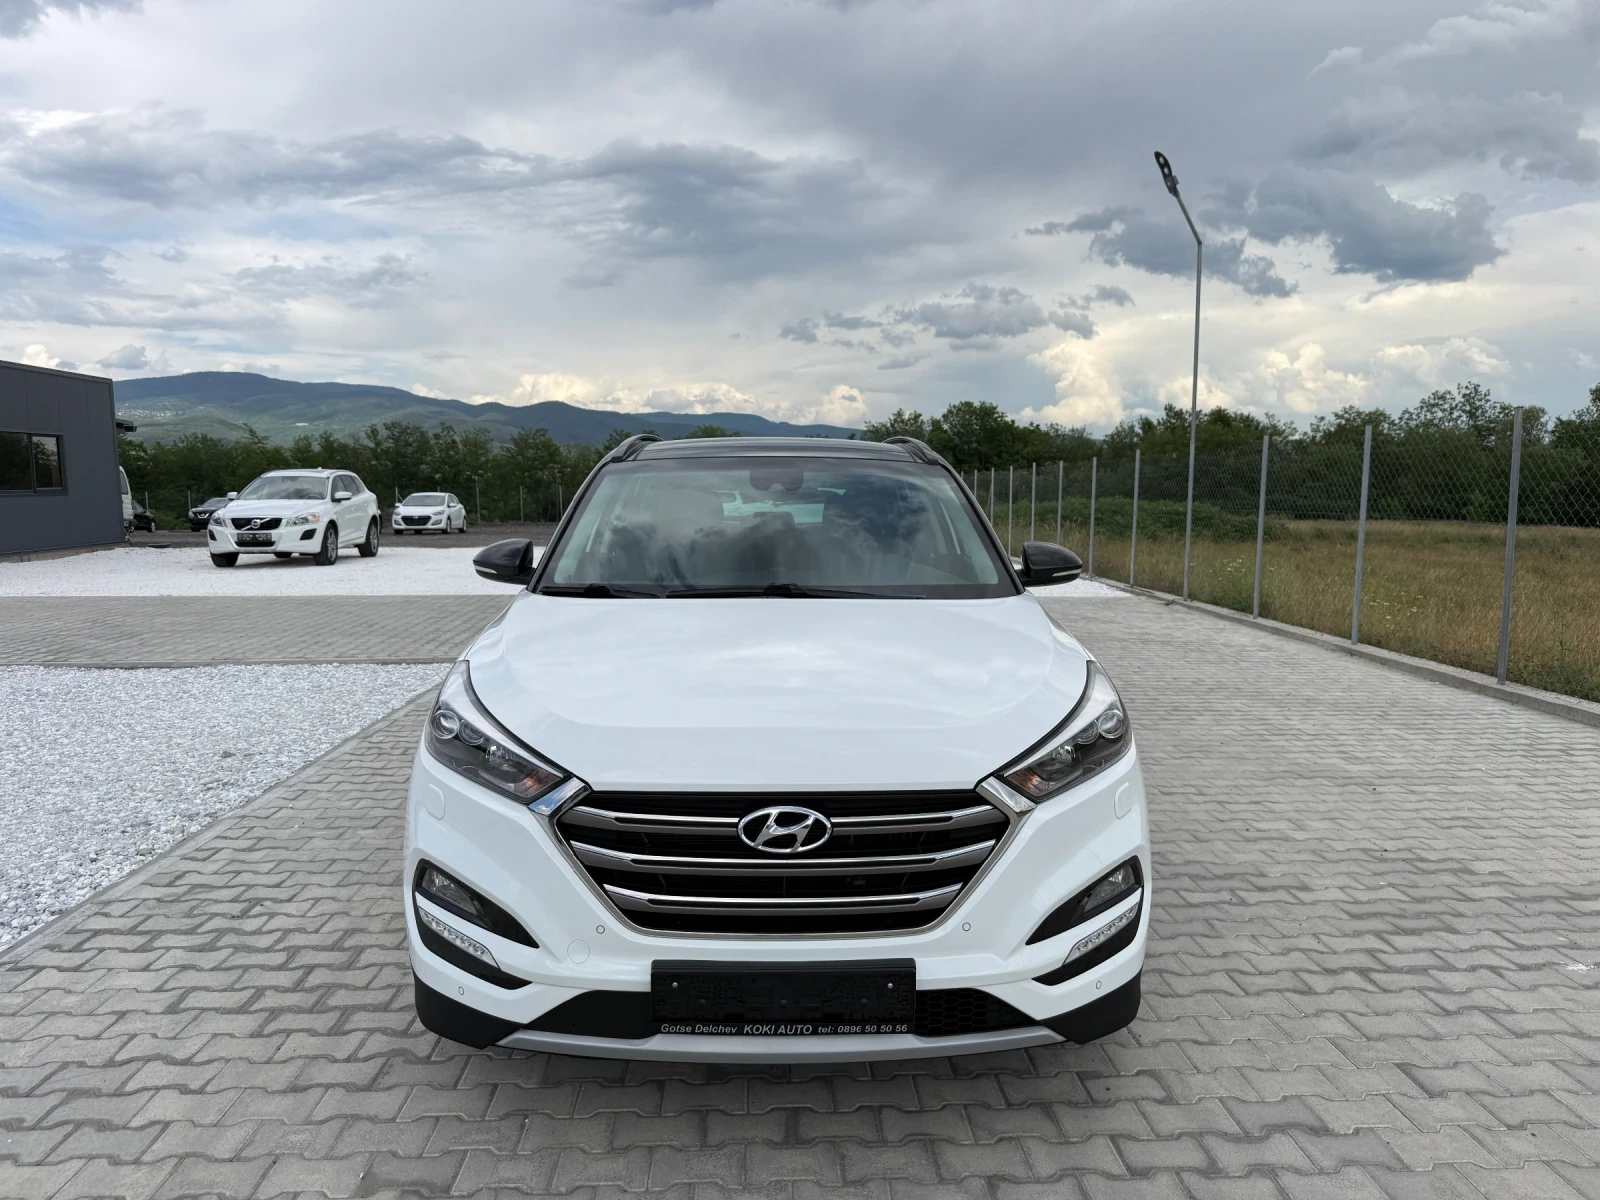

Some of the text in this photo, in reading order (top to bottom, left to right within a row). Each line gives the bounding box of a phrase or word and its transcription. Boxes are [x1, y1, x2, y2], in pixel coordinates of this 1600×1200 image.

[661, 1023, 908, 1035] Gotse Delchev KOKI AUTO tel: 0896 50 50 56
